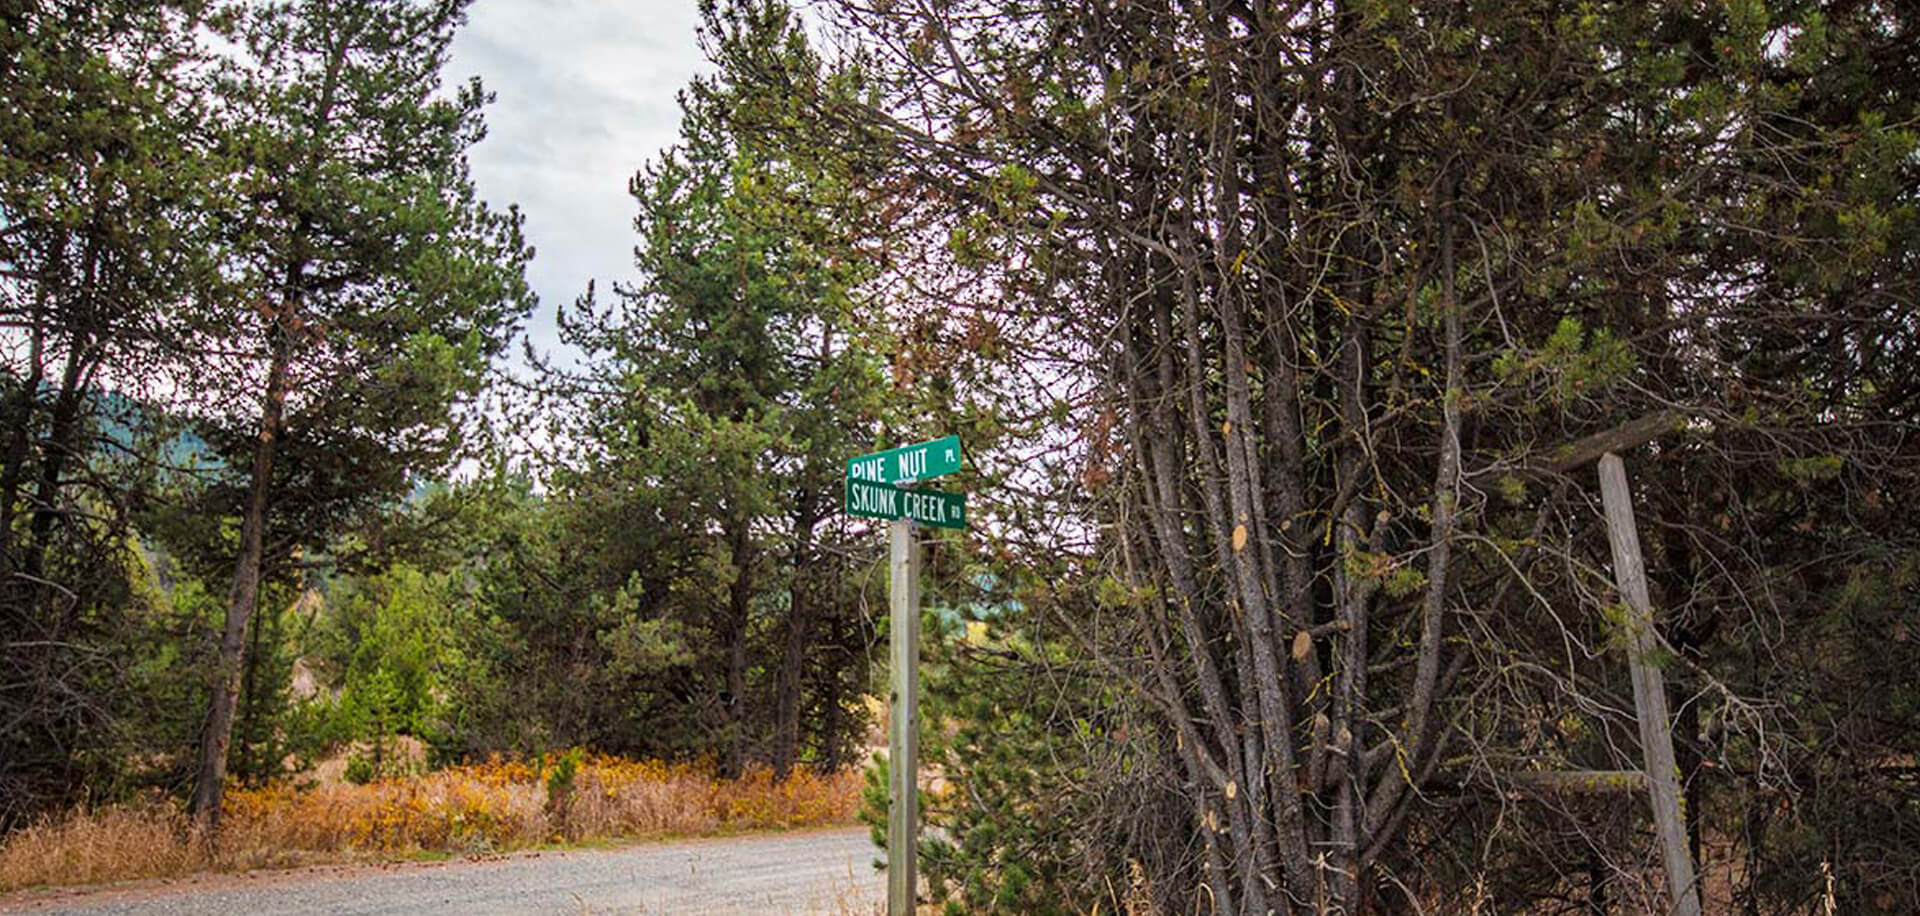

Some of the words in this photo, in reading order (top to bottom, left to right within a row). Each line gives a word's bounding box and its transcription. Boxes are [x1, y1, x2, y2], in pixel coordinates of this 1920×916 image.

[898, 448, 927, 478] NUT
[945, 448, 955, 462] PL
[852, 483, 897, 516] SKUNK
[904, 492, 946, 523] CREEK
[951, 505, 960, 519] RD
